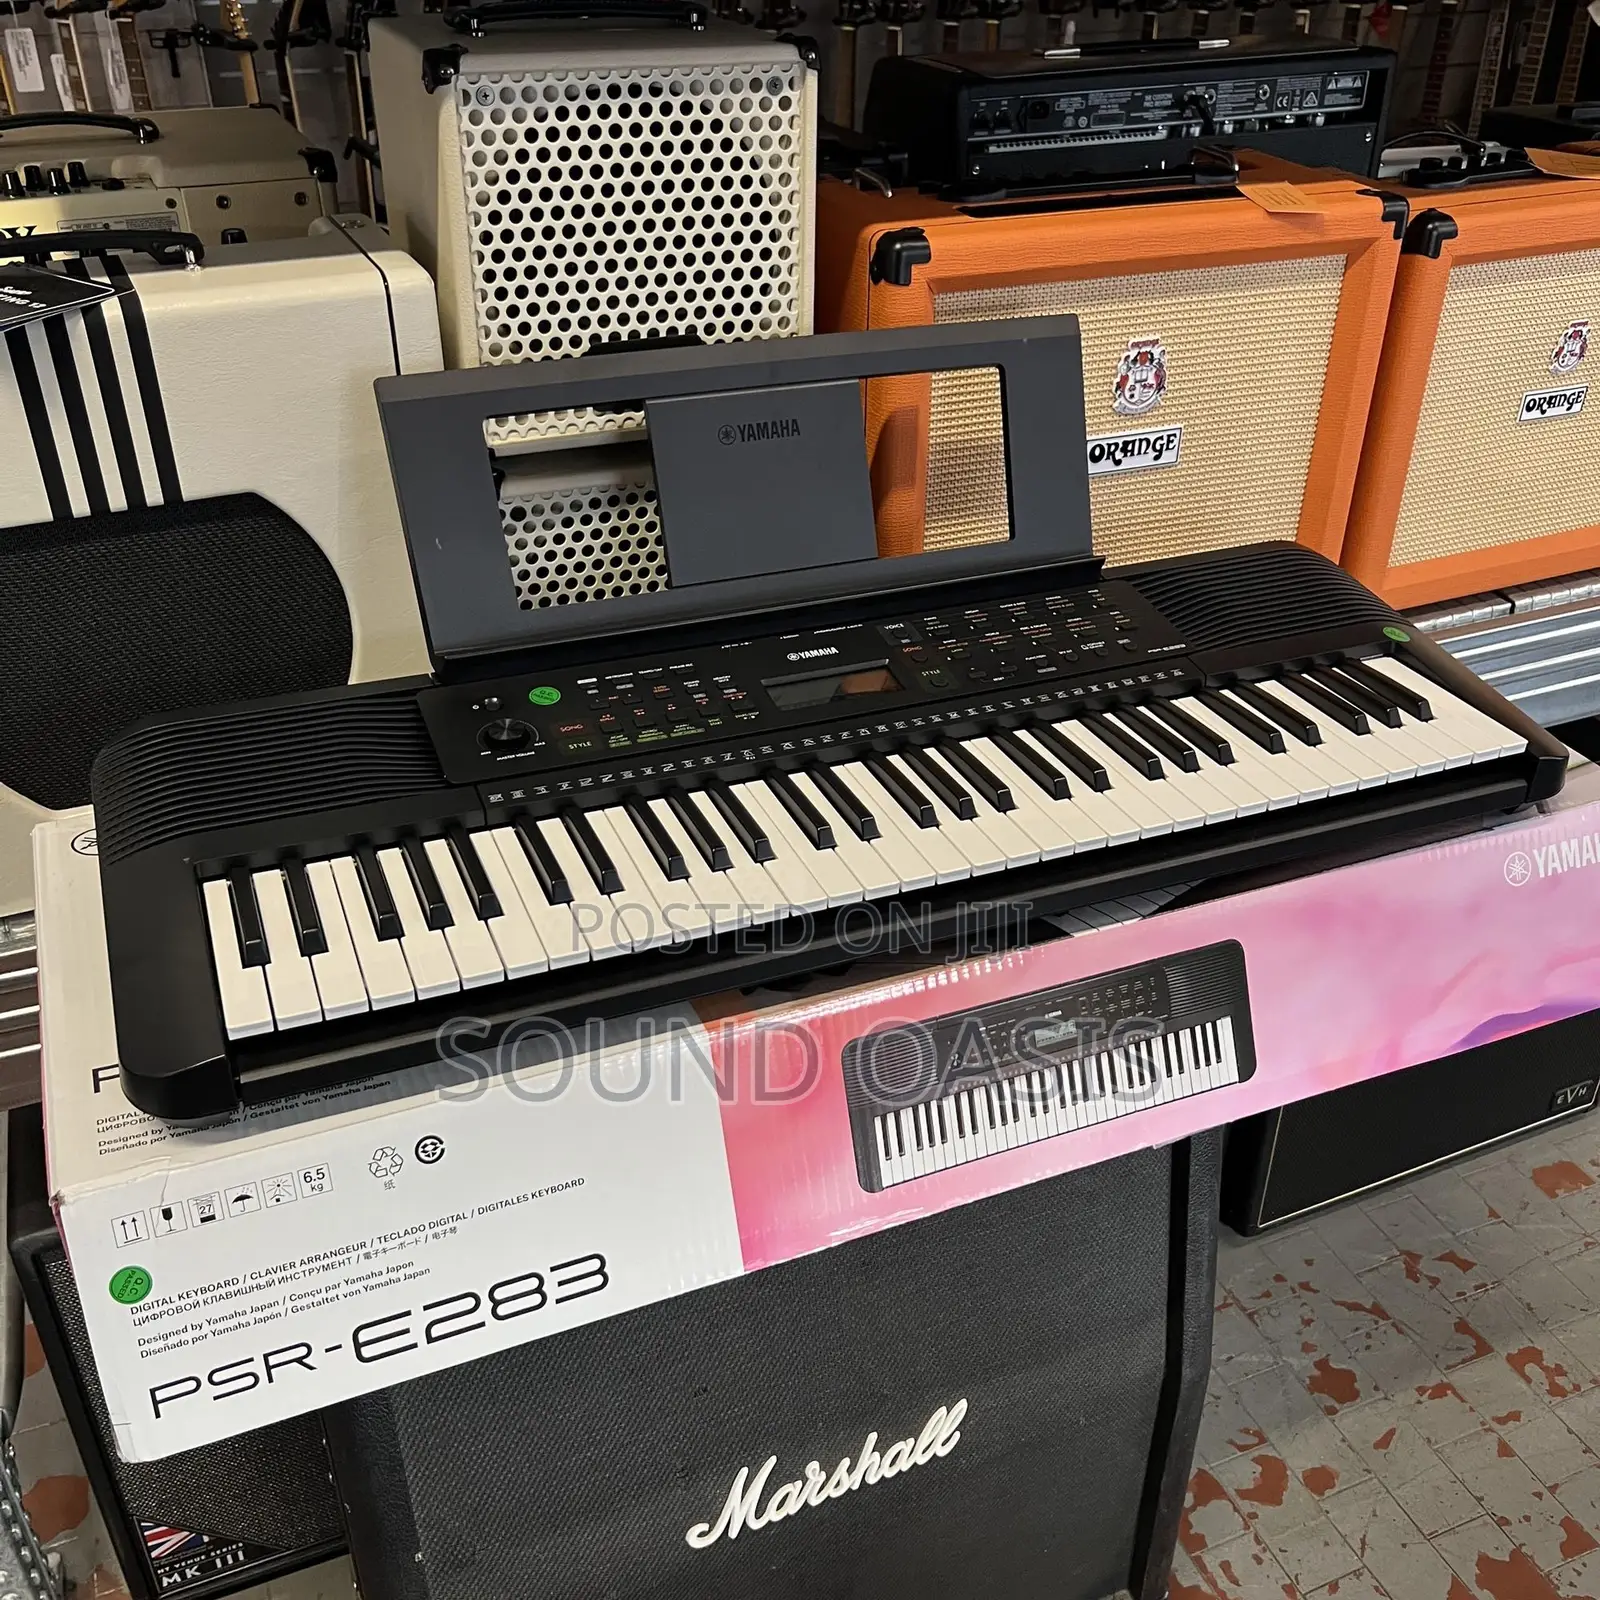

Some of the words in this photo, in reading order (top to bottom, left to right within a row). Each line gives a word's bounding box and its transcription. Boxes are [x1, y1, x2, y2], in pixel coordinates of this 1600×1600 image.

[1525, 390, 1585, 415] ORANGE
[737, 418, 801, 442] YAMAHA
[1089, 432, 1178, 466] ORANGE
[799, 646, 839, 660] YAMAHA
[921, 668, 941, 677] STYLE
[560, 723, 584, 733] SONG
[568, 740, 593, 750] STYLE
[1557, 1086, 1587, 1104] EVH
[96, 1110, 140, 1126] DIGITAL
[97, 1115, 156, 1134] ЦИФРОВО
[99, 1137, 148, 1156] Diseñado
[150, 1135, 167, 1145] por
[250, 1102, 299, 1119] Gestaltet
[302, 1098, 321, 1106] von
[322, 1087, 361, 1101] Yamaha
[363, 1080, 391, 1091] Japan
[98, 1129, 149, 1148] Designed
[151, 1127, 164, 1137] by
[303, 1168, 326, 1184] 6.5
[310, 1183, 324, 1193] kg
[199, 1204, 212, 1214] 27
[130, 1295, 176, 1315] DIGITAL
[177, 1277, 240, 1302] KEYBOARD
[250, 1261, 297, 1281] CLAVIER
[299, 1240, 367, 1267] ARRANGEUR
[376, 1223, 427, 1244] TECLADO
[428, 1211, 469, 1230] DIGITAL
[477, 1193, 530, 1216] DIGITALES
[530, 1177, 586, 1201] KEYBOARD
[117, 1270, 137, 1299] PASSED
[132, 1300, 201, 1327] ЦИФРОВОЙ
[203, 1277, 276, 1307] КЛАВИШНЫЙ
[278, 1255, 353, 1285] ИНСТРУМЕНТ
[362, 1236, 422, 1261] 電子キーボード
[431, 1225, 458, 1241] 电子琴
[137, 1325, 189, 1347] Designed
[190, 1321, 204, 1333] by
[205, 1308, 248, 1326] Yamaha
[249, 1299, 280, 1315] Japan
[289, 1286, 323, 1302] Conçu
[324, 1281, 342, 1294] par
[343, 1269, 384, 1287] Yamaha
[385, 1259, 415, 1275] Japon
[140, 1336, 190, 1359] Diseñado
[191, 1332, 209, 1346] por
[210, 1319, 251, 1337] Yamaha
[252, 1309, 282, 1326] Japón
[290, 1293, 340, 1314] Gestaltet
[342, 1287, 361, 1300] von
[362, 1276, 402, 1293] Yamaha
[402, 1267, 431, 1282] Japan
[148, 1252, 610, 1420] PSR-E283
[685, 1397, 969, 1549] Marshall
[162, 1565, 202, 1587] MK
[215, 1550, 245, 1569] III
